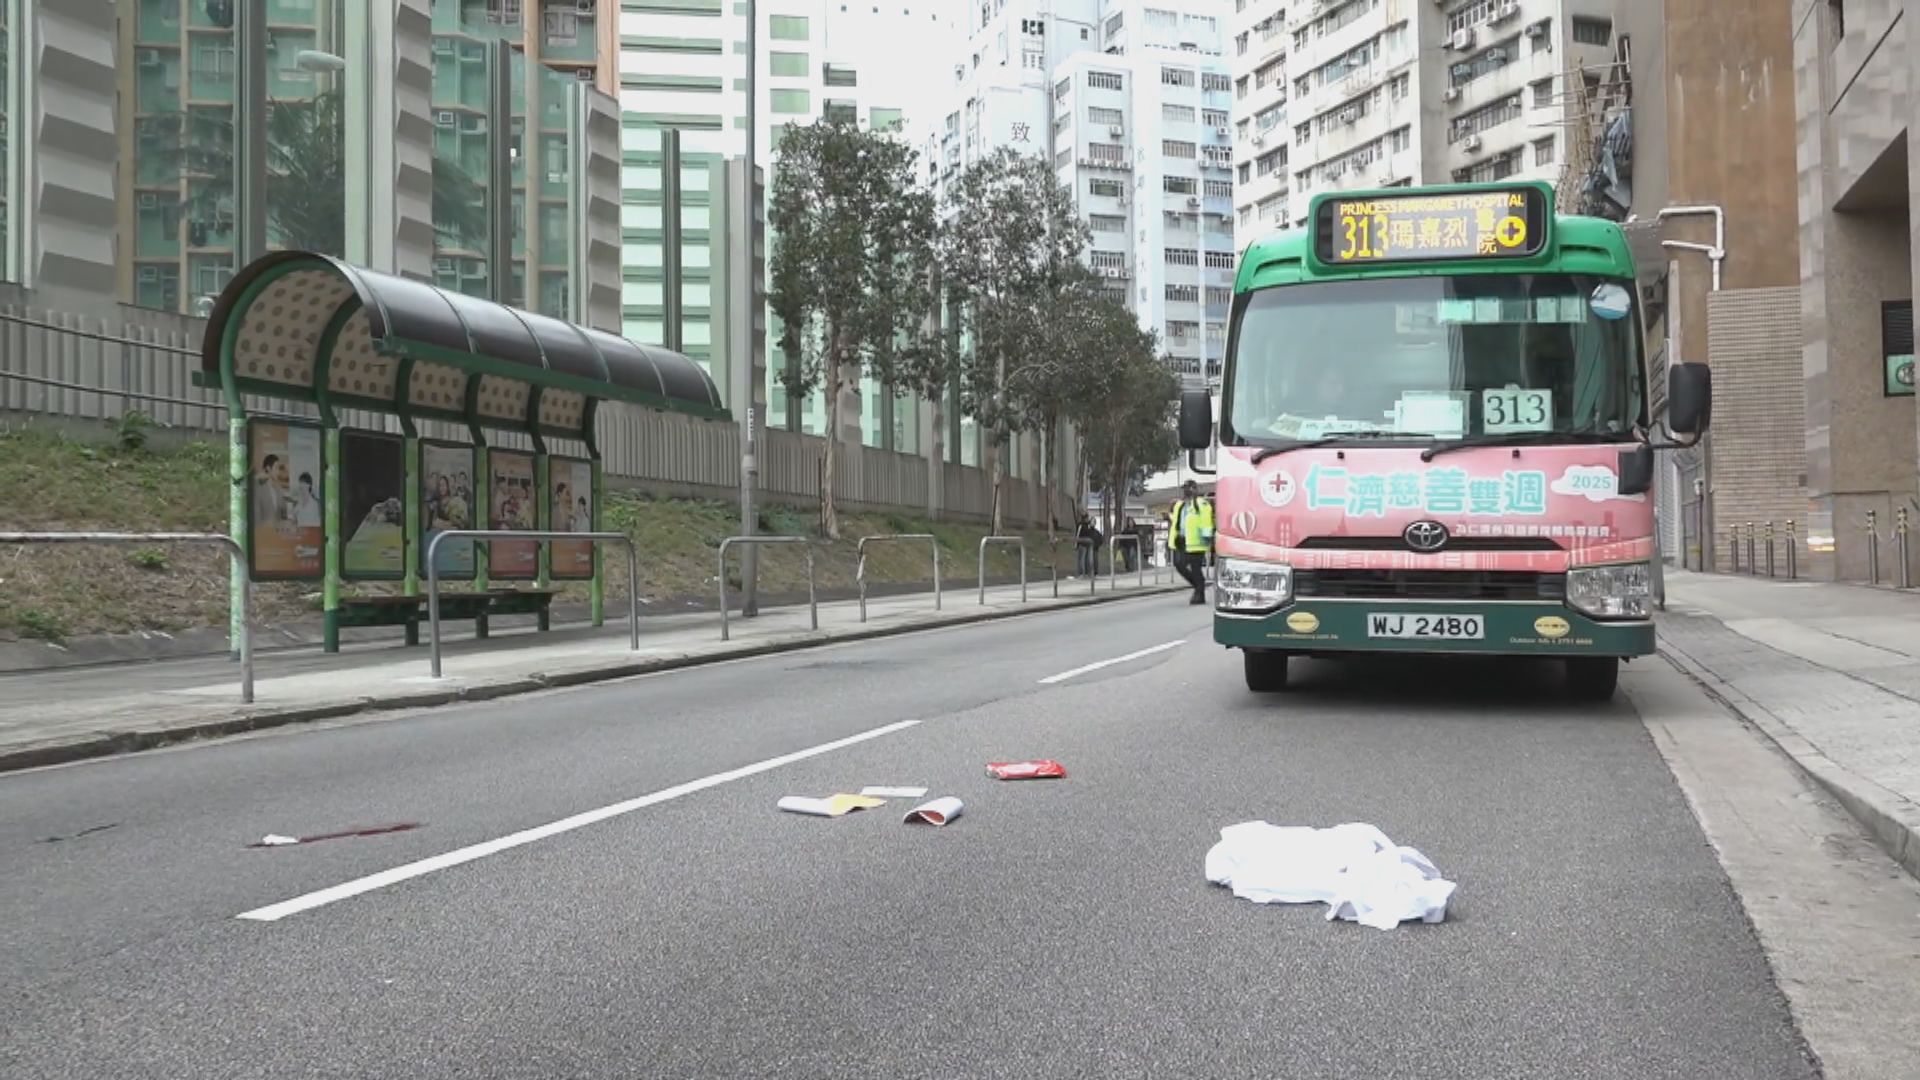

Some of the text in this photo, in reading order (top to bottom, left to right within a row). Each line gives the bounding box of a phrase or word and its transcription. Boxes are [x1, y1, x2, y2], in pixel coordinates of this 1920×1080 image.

[1011, 121, 1031, 143] 致
[1340, 200, 1397, 215] PRINCESS
[1462, 194, 1525, 209] HOSPITAL
[1340, 213, 1390, 260] 313
[1487, 394, 1546, 425] 313
[1304, 464, 1546, 516] 仁濟慈善雙週
[1571, 475, 1611, 489] 2025
[1373, 616, 1479, 636] WJ 2480
